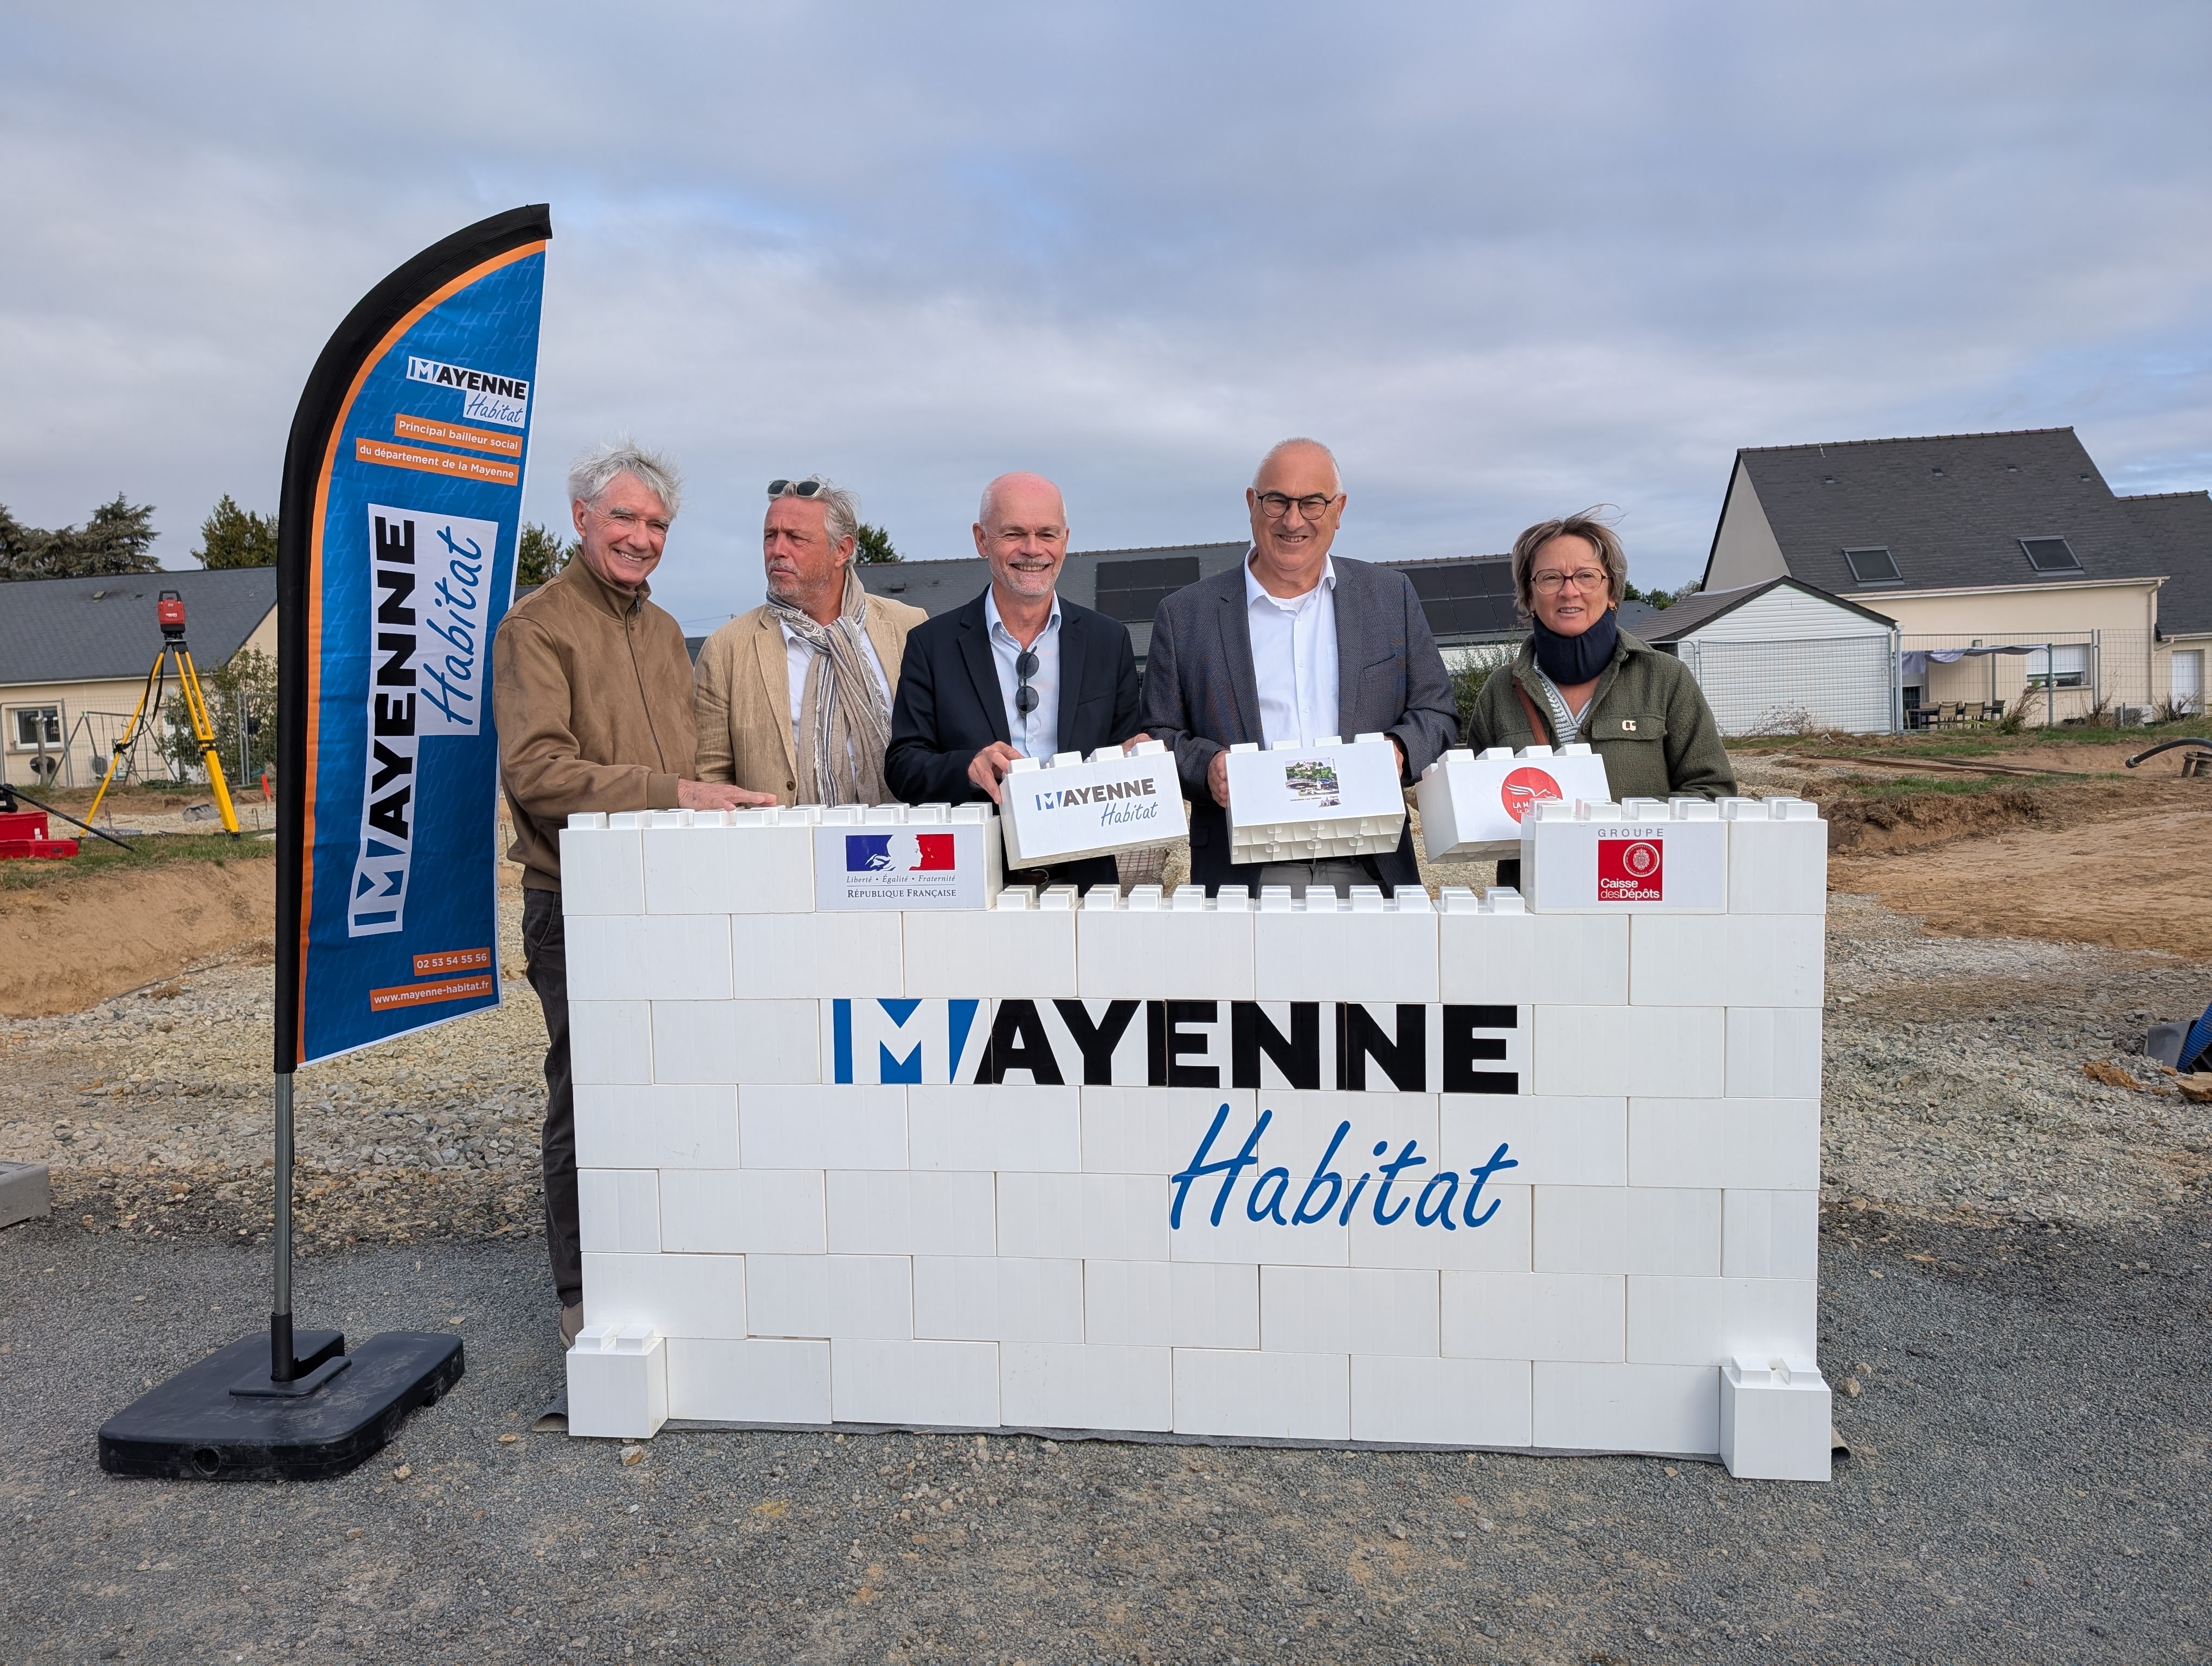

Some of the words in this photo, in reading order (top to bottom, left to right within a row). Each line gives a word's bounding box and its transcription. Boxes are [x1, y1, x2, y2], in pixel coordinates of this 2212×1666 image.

[409, 358, 526, 400] MAYENNE
[467, 393, 522, 423] Habitat
[398, 420, 446, 437] Principal
[448, 429, 488, 444] bailleur
[490, 438, 518, 450] social
[359, 445, 372, 456] du
[374, 447, 439, 465] département
[442, 459, 455, 469] de
[458, 462, 468, 471] la
[470, 465, 514, 477] Mayenne
[420, 524, 483, 727] Habitat
[353, 515, 416, 937] MAYENNE
[1035, 778, 1156, 811] MAYENNE
[1101, 802, 1159, 827] Habitat
[1598, 828, 1664, 837] GROUPE
[846, 875, 872, 883] Liberté
[882, 873, 909, 885] Égalité
[918, 874, 956, 882] Fraternité
[847, 888, 904, 899] RÉPUBLIQUE
[906, 888, 956, 898] FRANÇAISE
[1600, 878, 1638, 888] Caisse
[1600, 888, 1660, 901] desDépôts
[416, 960, 429, 969] 02
[432, 958, 443, 966] 53
[446, 956, 459, 965] 54
[461, 954, 473, 964] 55
[475, 953, 487, 962] 56
[374, 981, 488, 1003] www.mayenne-habitat.fr
[833, 998, 1519, 1095] MAYENNE
[1169, 1103, 1518, 1231] Habitat
